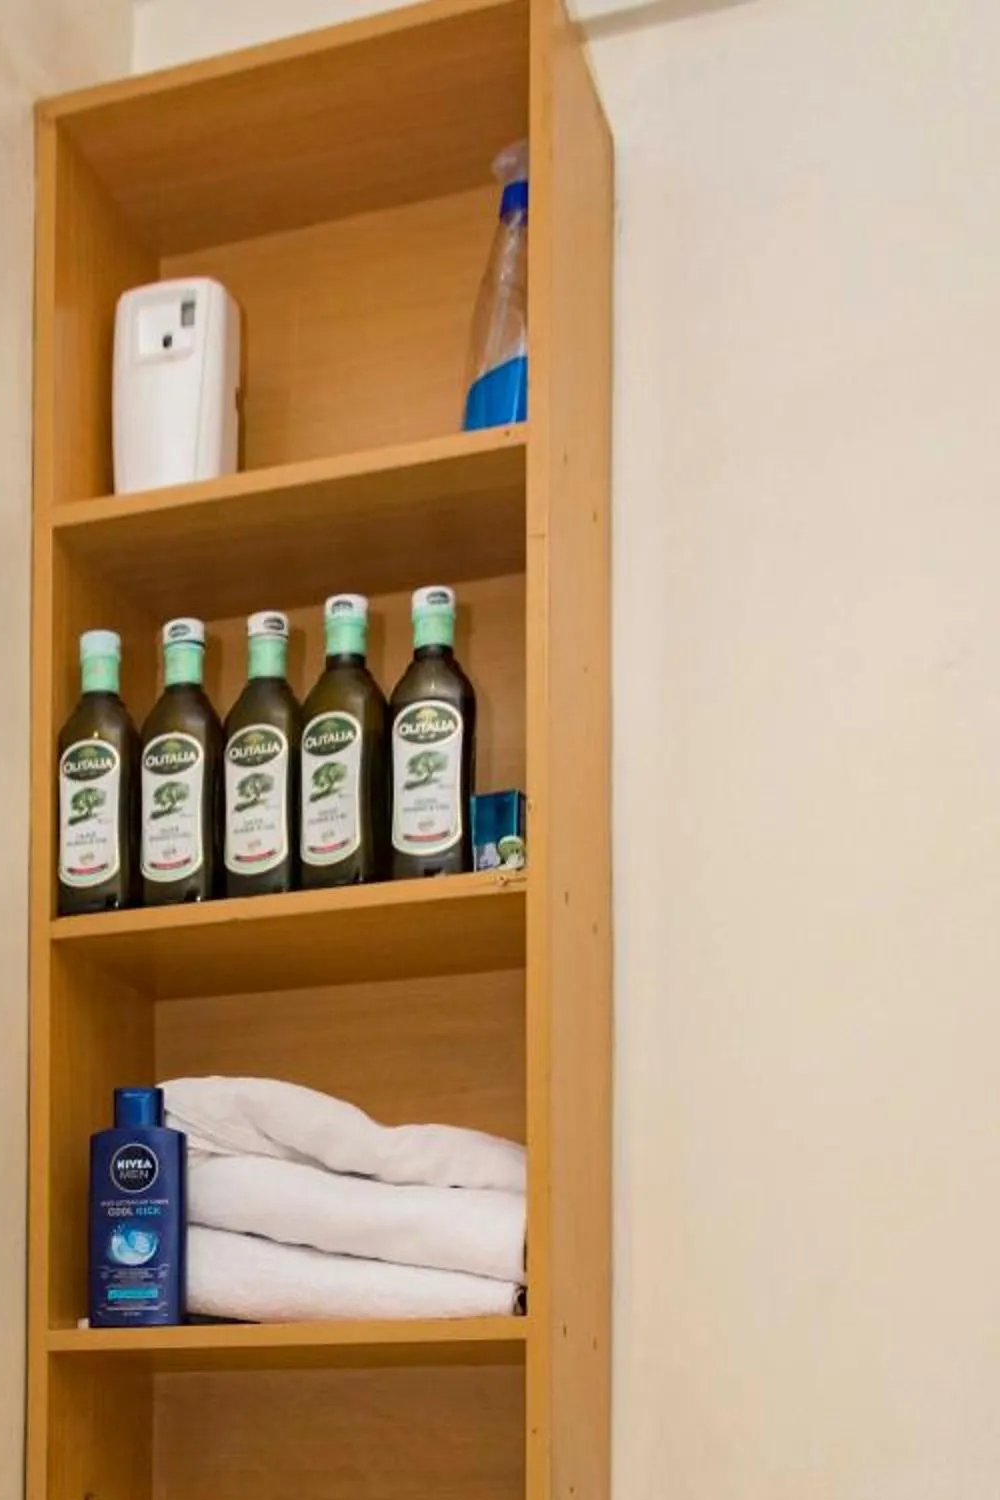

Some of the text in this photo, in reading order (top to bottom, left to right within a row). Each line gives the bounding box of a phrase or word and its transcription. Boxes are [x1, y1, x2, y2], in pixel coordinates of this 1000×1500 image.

[400, 719, 455, 735] OLITALIA
[305, 731, 354, 749] OLITALIA
[229, 741, 281, 759] OLITALIA
[63, 757, 113, 773] OLITALIA
[145, 751, 197, 767] OLITALIA
[117, 1158, 153, 1169] NIVEA
[119, 1169, 149, 1180] MEN
